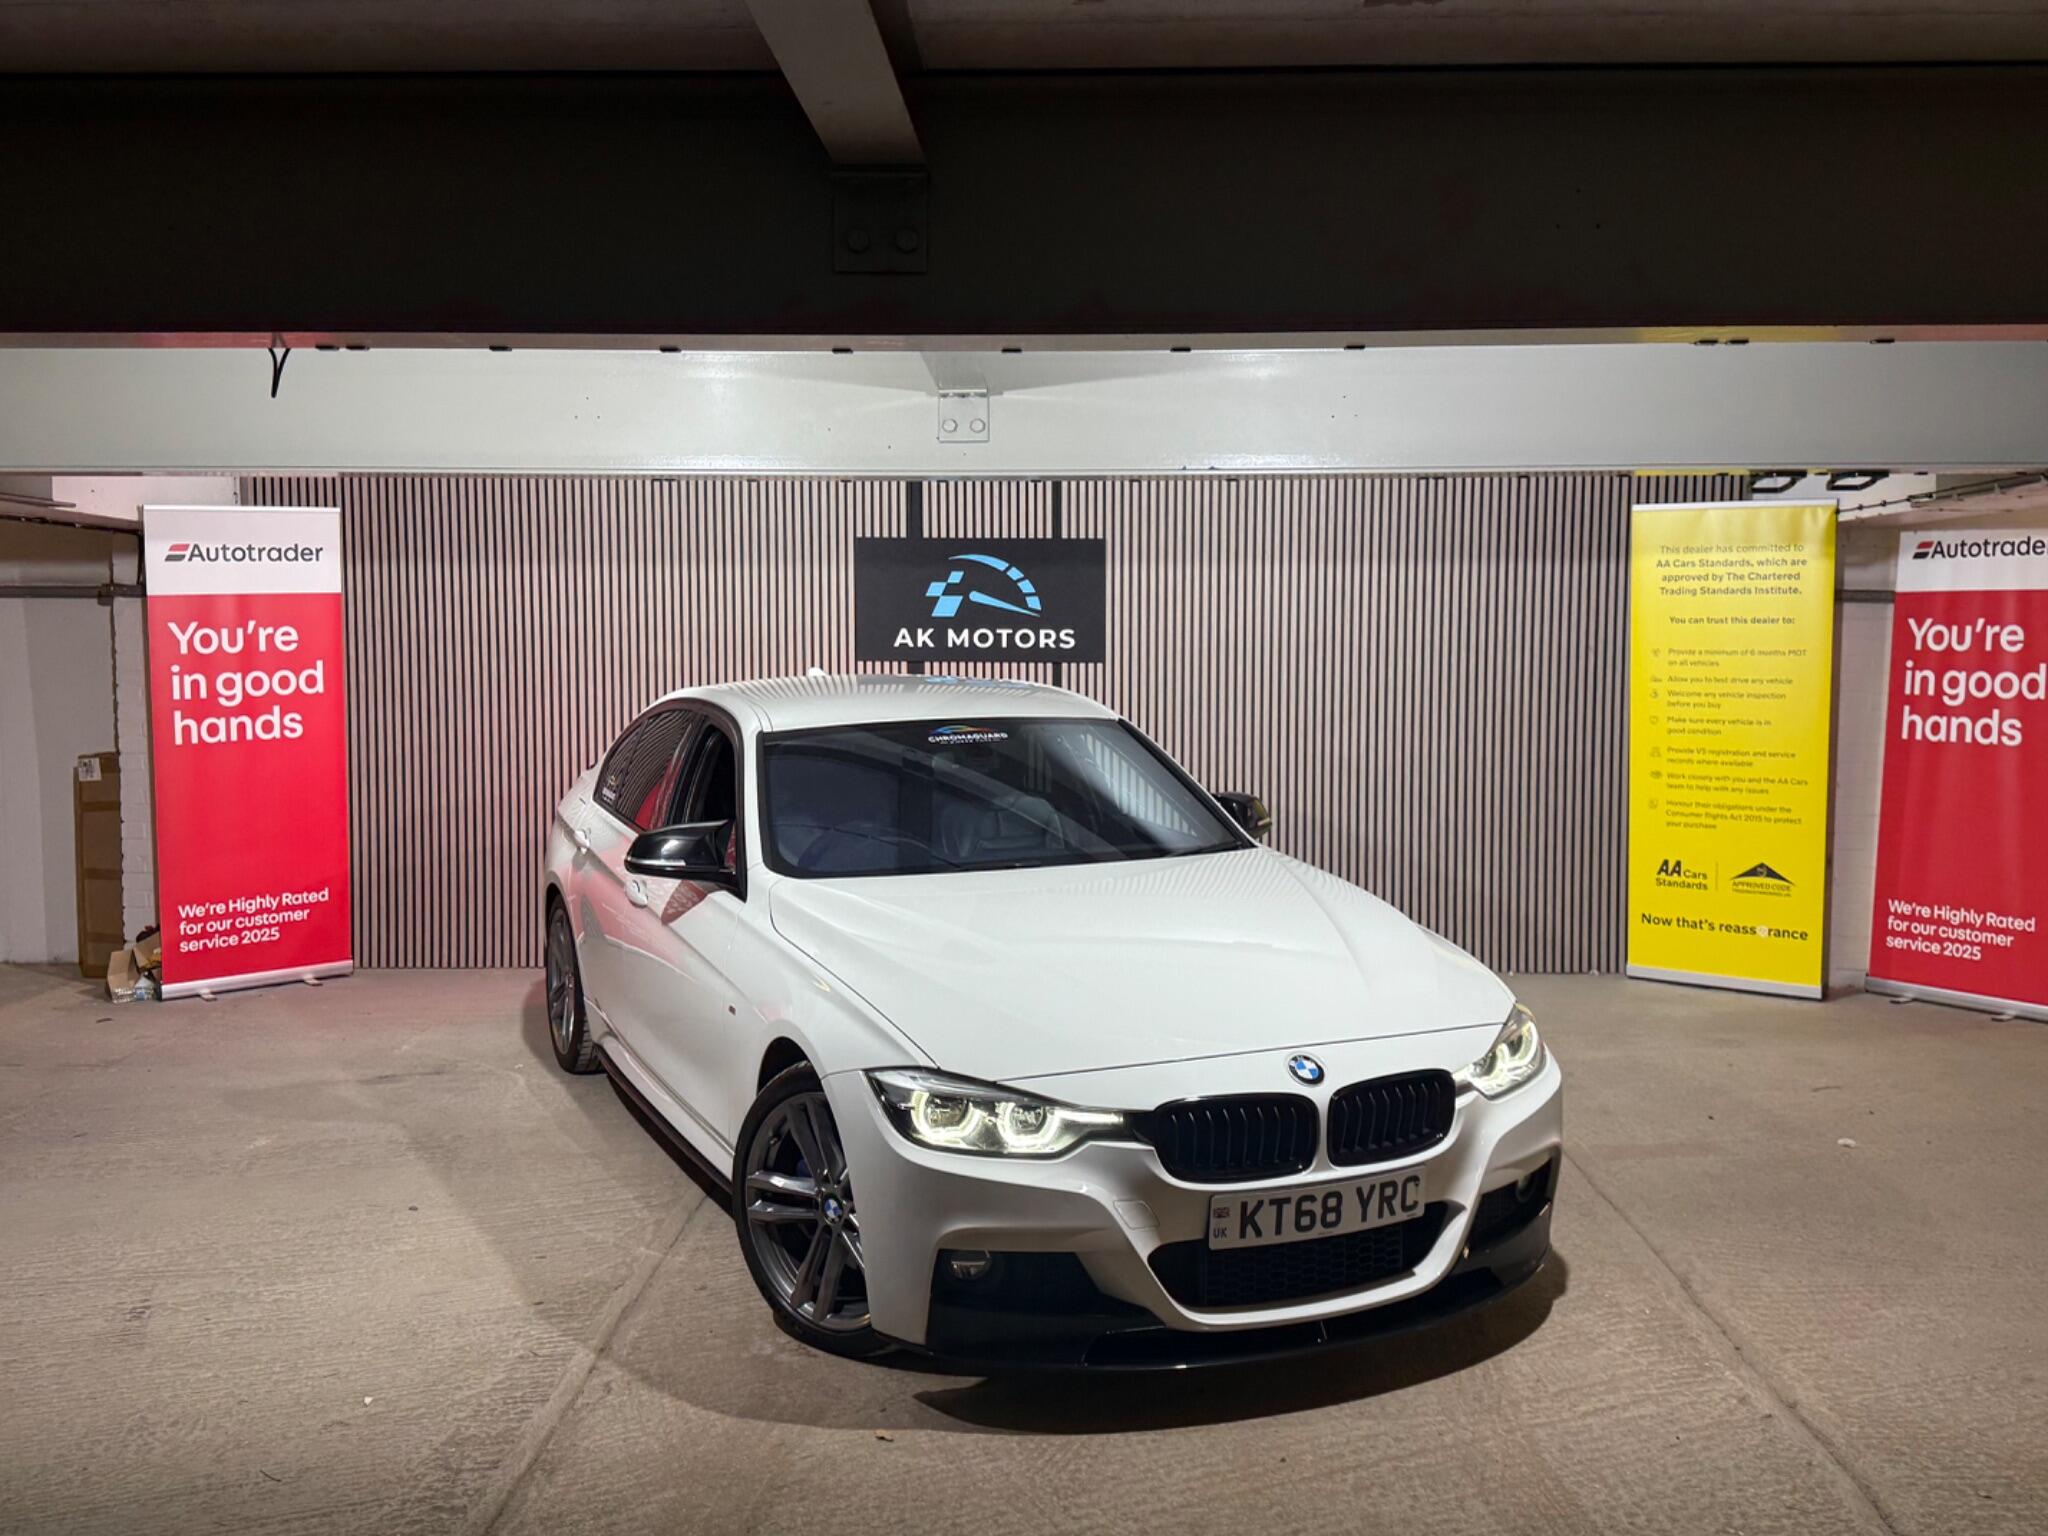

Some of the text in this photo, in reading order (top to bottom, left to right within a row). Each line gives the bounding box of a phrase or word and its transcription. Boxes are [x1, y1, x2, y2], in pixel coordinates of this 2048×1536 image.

[187, 543, 324, 563] Autotrader
[1931, 536, 2048, 559] Autotrade
[1656, 560, 1670, 568] AA
[1673, 559, 1696, 568] Cars
[1757, 558, 1788, 567] which
[1662, 572, 1801, 582] approved by The Chartered
[1660, 587, 1697, 597] Trading
[1700, 586, 1752, 595] Standards
[1670, 616, 1686, 625] You
[1706, 617, 1728, 625] trust
[1731, 616, 1748, 625] this
[1750, 616, 1780, 625] dealer
[167, 620, 299, 655] You're
[893, 627, 1076, 649] AK MOTORS
[1907, 618, 2025, 653] You're
[170, 659, 325, 707] in good
[1904, 660, 2047, 706] in good
[173, 705, 304, 745] hands
[1902, 705, 2022, 746] hands
[1657, 859, 1708, 880] AA Cars
[1656, 877, 1708, 891] Standards
[178, 887, 329, 919] We're Highly Rated
[1888, 899, 2036, 933] We're Highly Rated
[179, 908, 311, 936] for our customer
[1641, 912, 1809, 941] Now that's reassrance
[1887, 916, 2014, 947] for our customer
[179, 926, 281, 953] service 2025
[1886, 935, 1983, 961] service 2025
[1239, 1174, 1421, 1240] KT68 YRC
[1213, 1226, 1228, 1239] UK
